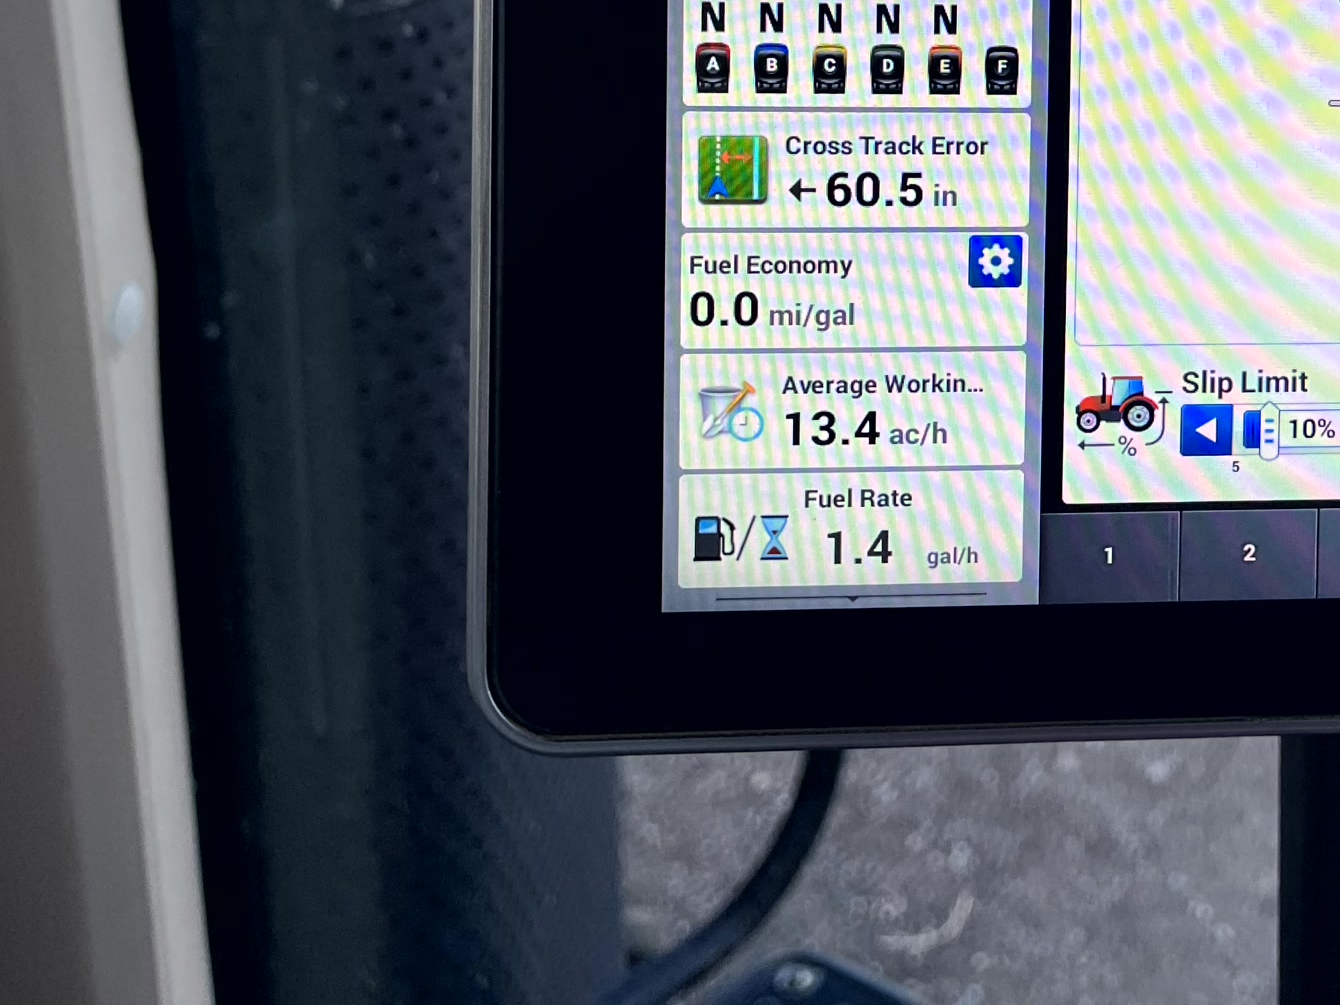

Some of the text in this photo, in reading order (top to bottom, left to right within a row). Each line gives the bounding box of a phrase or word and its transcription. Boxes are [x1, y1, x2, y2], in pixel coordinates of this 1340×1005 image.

[701, 2, 726, 33] N
[759, 2, 784, 33] N
[818, 3, 842, 34] N
[876, 3, 900, 34] N
[933, 4, 958, 35] N
[706, 56, 720, 71] A
[766, 58, 778, 72] B
[824, 58, 837, 72] C
[882, 59, 894, 72] D
[939, 59, 951, 73] E
[998, 60, 1008, 73] F
[785, 136, 989, 155] Cross Track Error
[826, 172, 958, 207] 60.5 in
[689, 255, 852, 278] Fuel Economy
[690, 291, 855, 331] 0.0 mi/gal
[782, 373, 984, 398] Average Workin...
[1182, 371, 1309, 398] Slip Limit
[785, 410, 948, 446] 13.4 ac/h
[1288, 418, 1336, 439] 10%
[1118, 435, 1137, 457] %
[1232, 461, 1240, 473] 5
[804, 489, 912, 508] Fuel Rate
[827, 530, 979, 568] 1.4 gal/h
[1103, 547, 1113, 564] 1
[1243, 545, 1256, 562] 2
